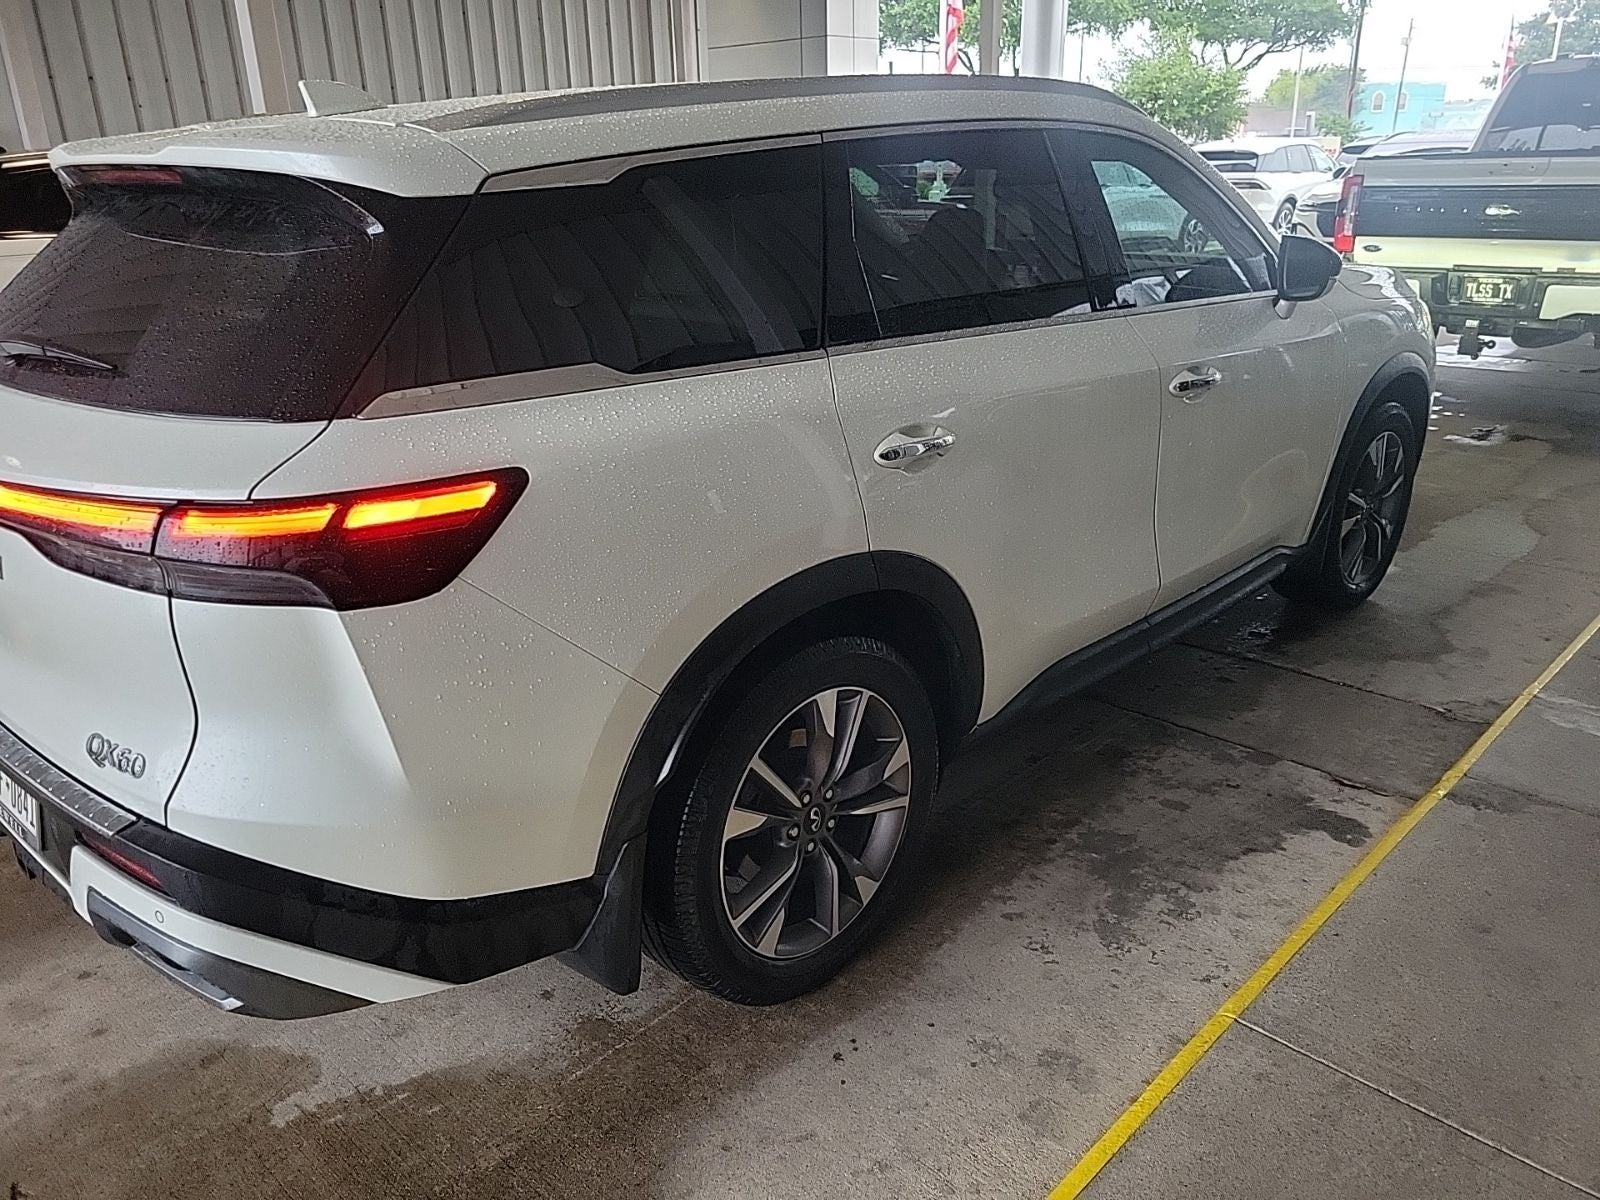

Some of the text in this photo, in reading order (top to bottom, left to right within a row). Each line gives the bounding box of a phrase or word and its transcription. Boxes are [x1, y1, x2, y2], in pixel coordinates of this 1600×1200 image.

[1466, 282, 1513, 299] TLSS TX
[85, 732, 146, 779] QX60
[0, 774, 36, 830] 0841
